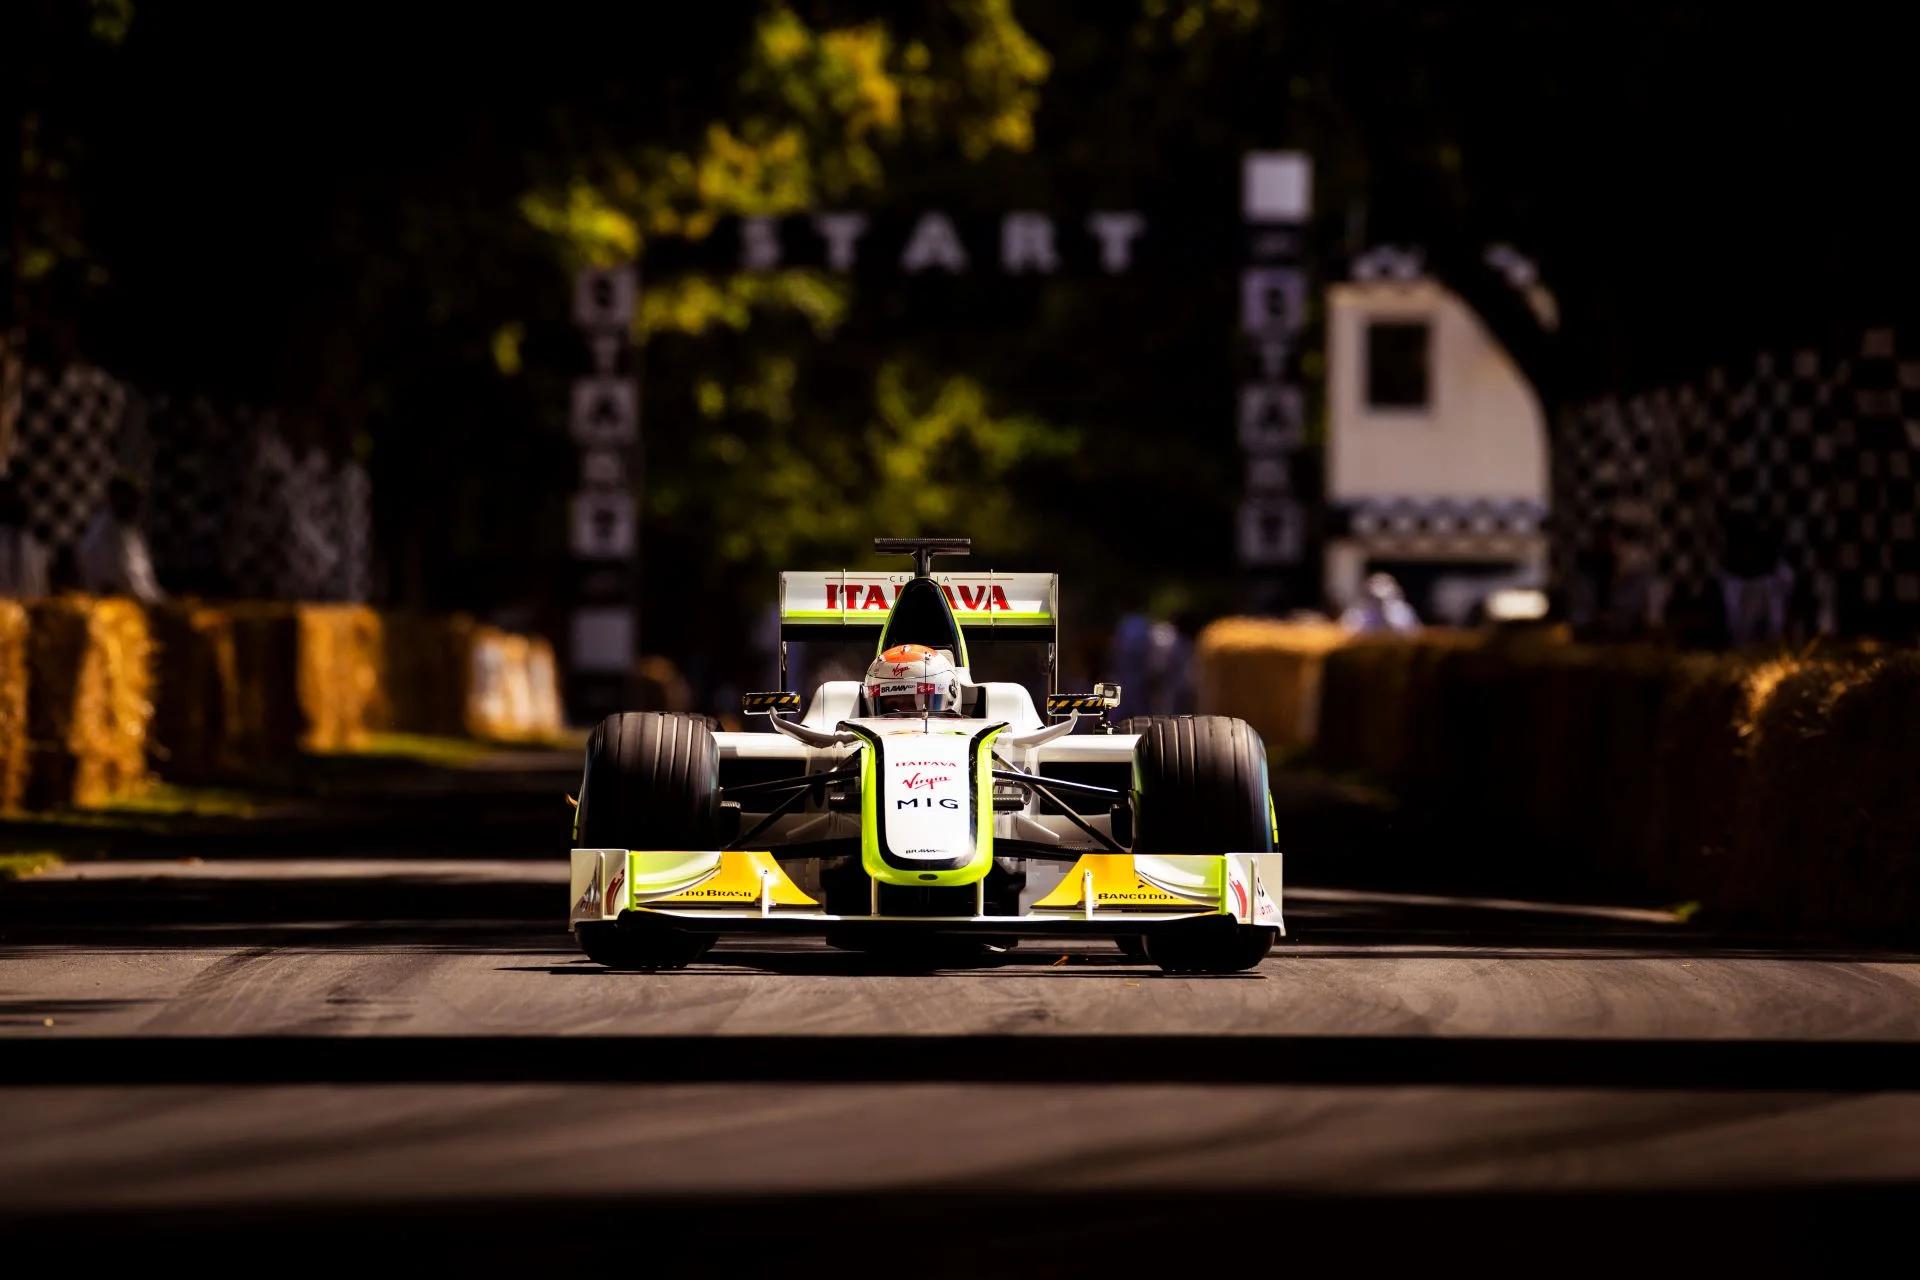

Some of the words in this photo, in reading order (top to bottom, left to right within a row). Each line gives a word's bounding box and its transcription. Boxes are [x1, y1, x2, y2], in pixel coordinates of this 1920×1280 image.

[741, 212, 1145, 273] START
[889, 575, 950, 583] CERJA
[825, 584, 1012, 610] ITAVA
[902, 773, 952, 789] Virgin
[897, 798, 958, 809] MIG
